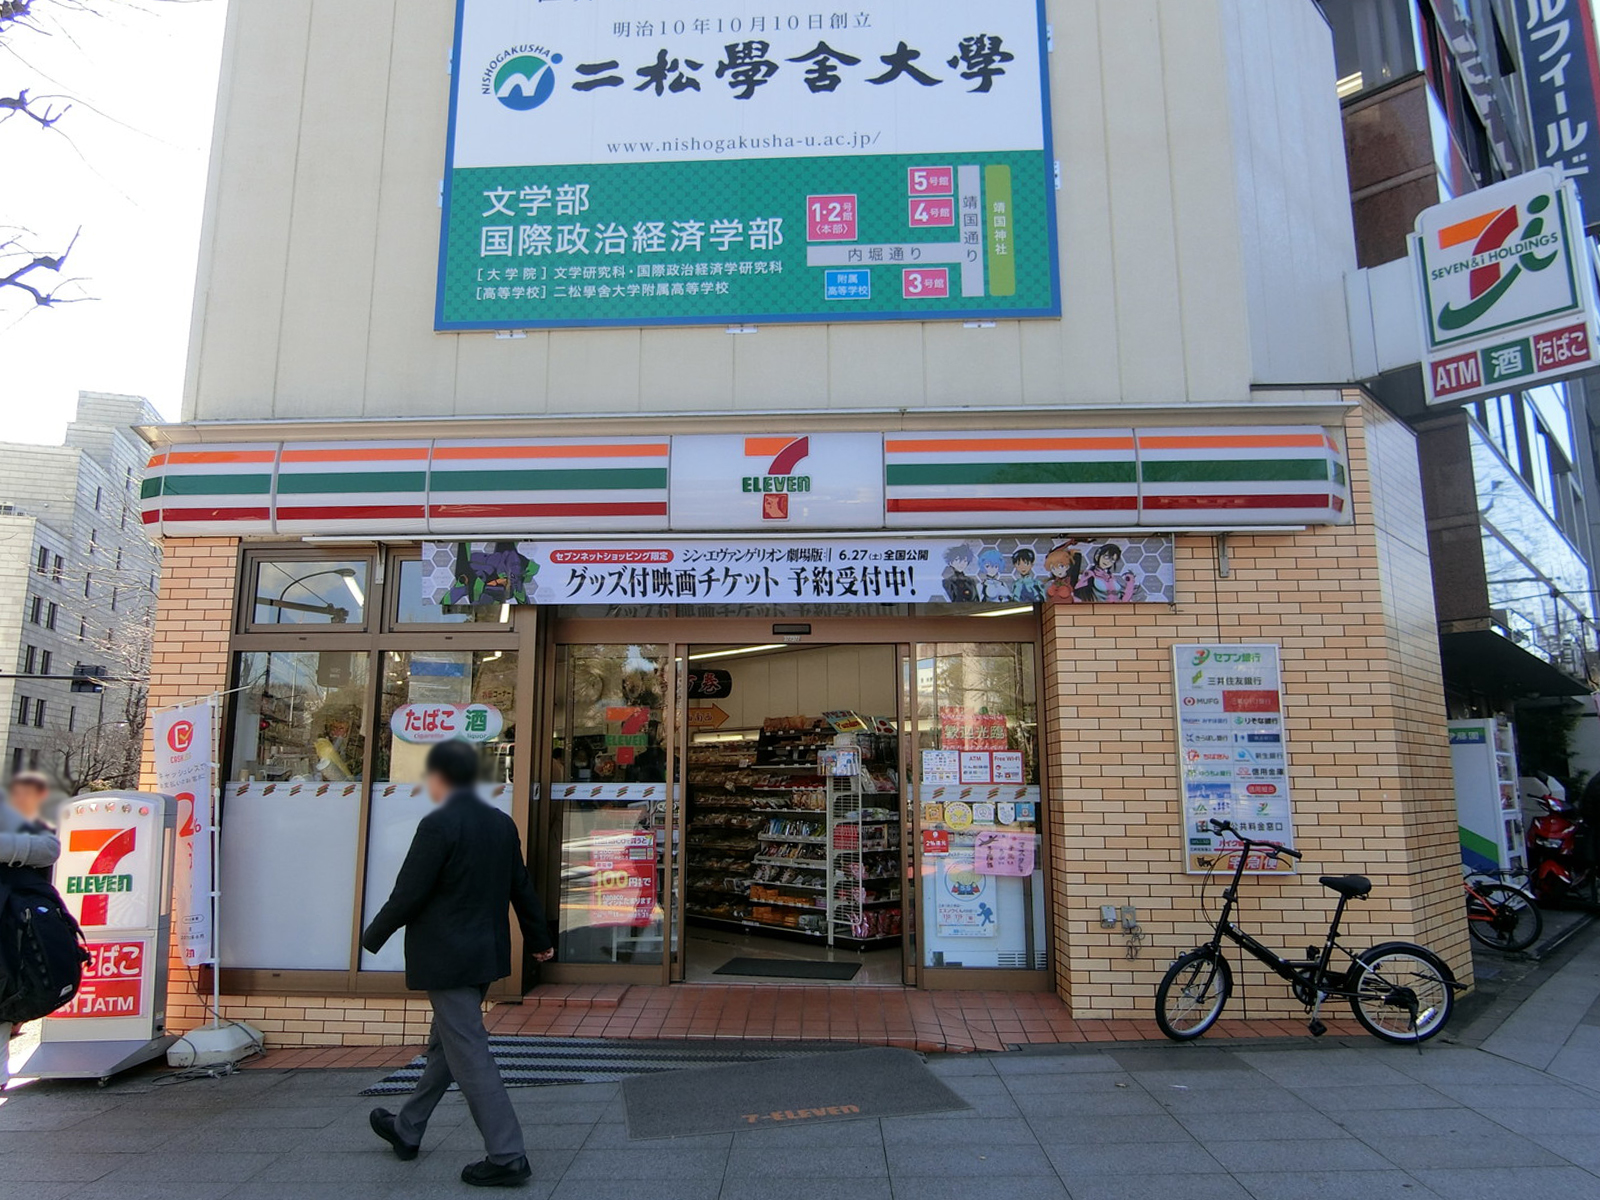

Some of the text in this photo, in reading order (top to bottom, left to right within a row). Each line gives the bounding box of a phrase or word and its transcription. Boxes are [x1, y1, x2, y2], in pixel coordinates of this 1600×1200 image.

[612, 11, 873, 39] 明治10年10月10日創立
[481, 44, 552, 95] NISHOGAKUSHA
[606, 131, 882, 155] www.nishogakusha-u.ac.jp/
[481, 184, 590, 218] 文学部
[480, 218, 784, 257] 国際政治経済学部
[962, 195, 979, 262] 靖国通り
[993, 201, 1008, 256] 靖国神社
[847, 246, 922, 262] 内堀通り
[1488, 231, 1559, 264] HOLDINGS
[1490, 345, 1523, 379] 酒
[1536, 331, 1588, 366] たばこ
[1435, 358, 1478, 391] ATM
[554, 551, 669, 562] セブンネットショッピング限定
[565, 564, 917, 598] グッズ付映画チケット 予約受付中!
[1213, 652, 1262, 664] セブン銀行
[1207, 676, 1263, 686] 三井住友銀行
[1196, 697, 1220, 705] MUFG
[404, 708, 455, 732] たばこ
[464, 708, 488, 732] 酒
[1244, 717, 1279, 725] りそな銀行
